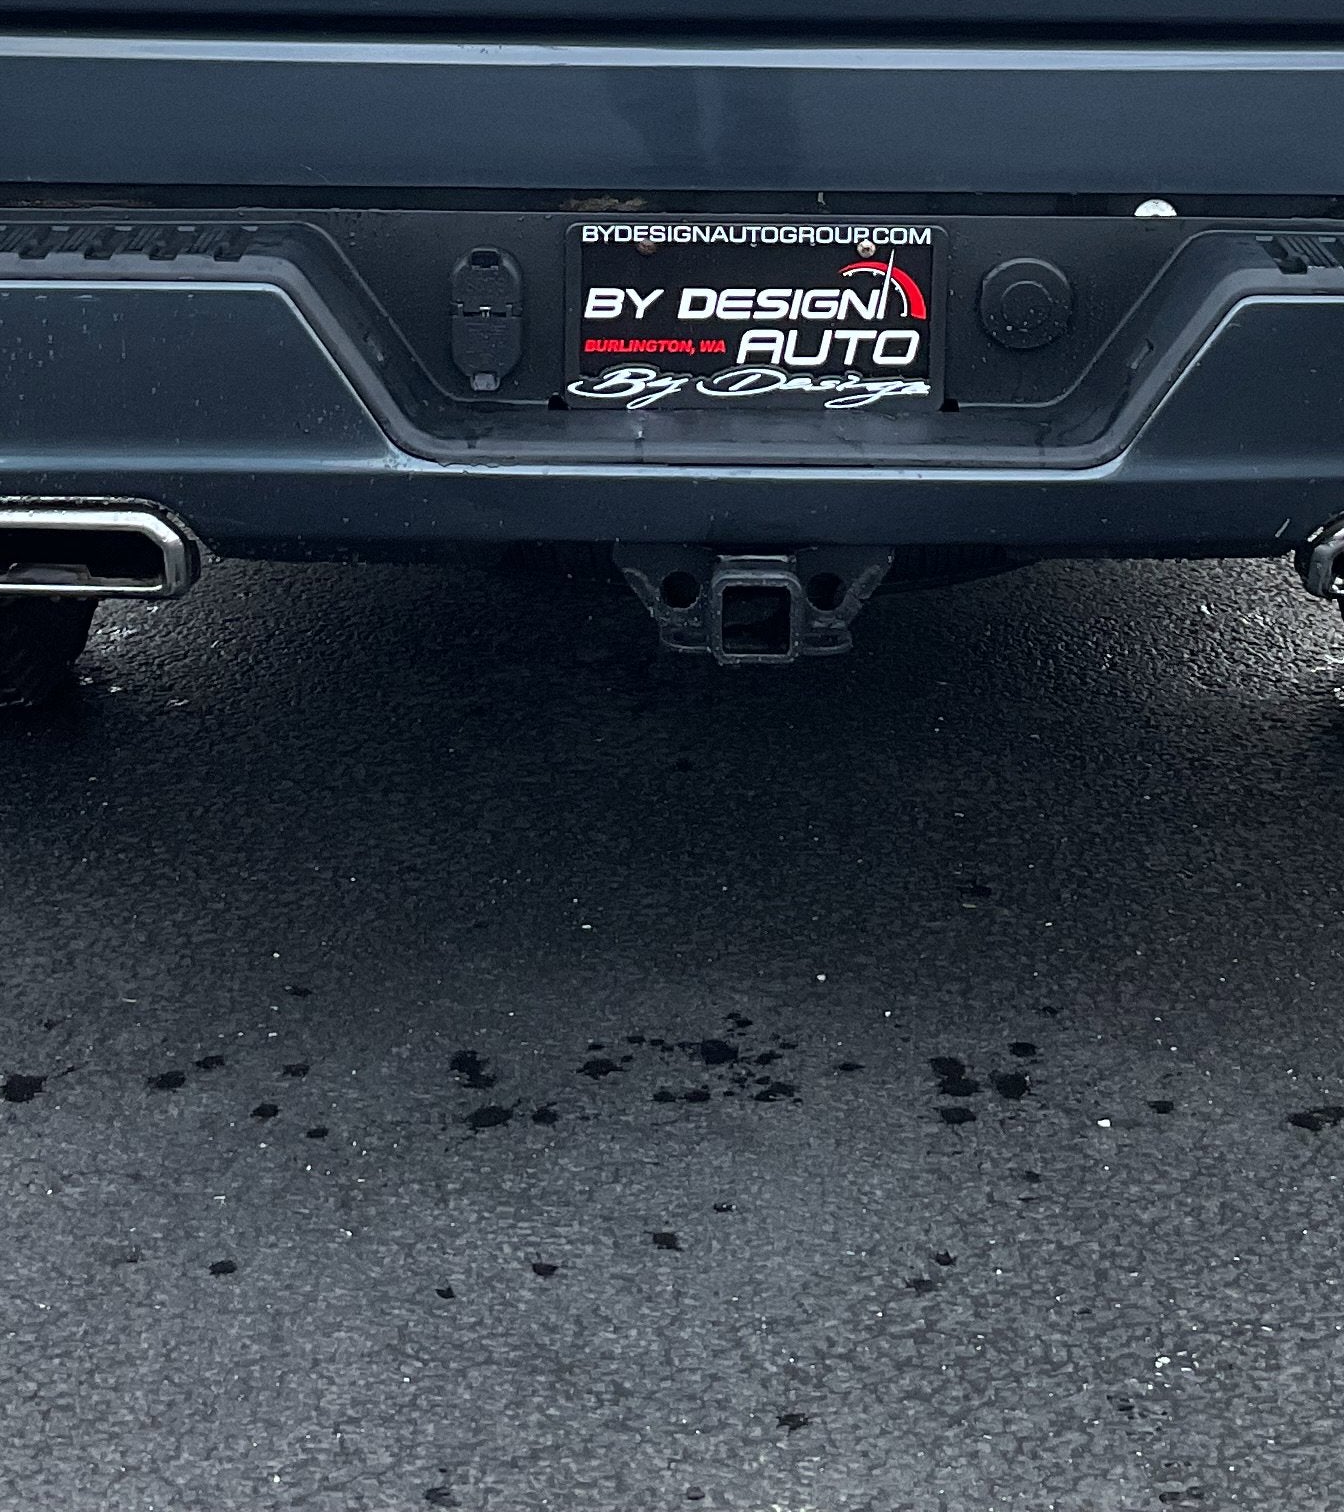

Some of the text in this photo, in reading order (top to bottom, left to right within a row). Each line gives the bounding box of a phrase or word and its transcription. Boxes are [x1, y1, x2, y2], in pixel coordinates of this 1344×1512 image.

[581, 224, 932, 246] BYDESIGNAUTOGROUP.COM
[584, 288, 886, 320] BY DESIGN
[583, 338, 727, 356] BURLINGTON, WA
[735, 329, 921, 367] AUTO
[567, 367, 693, 410] By
